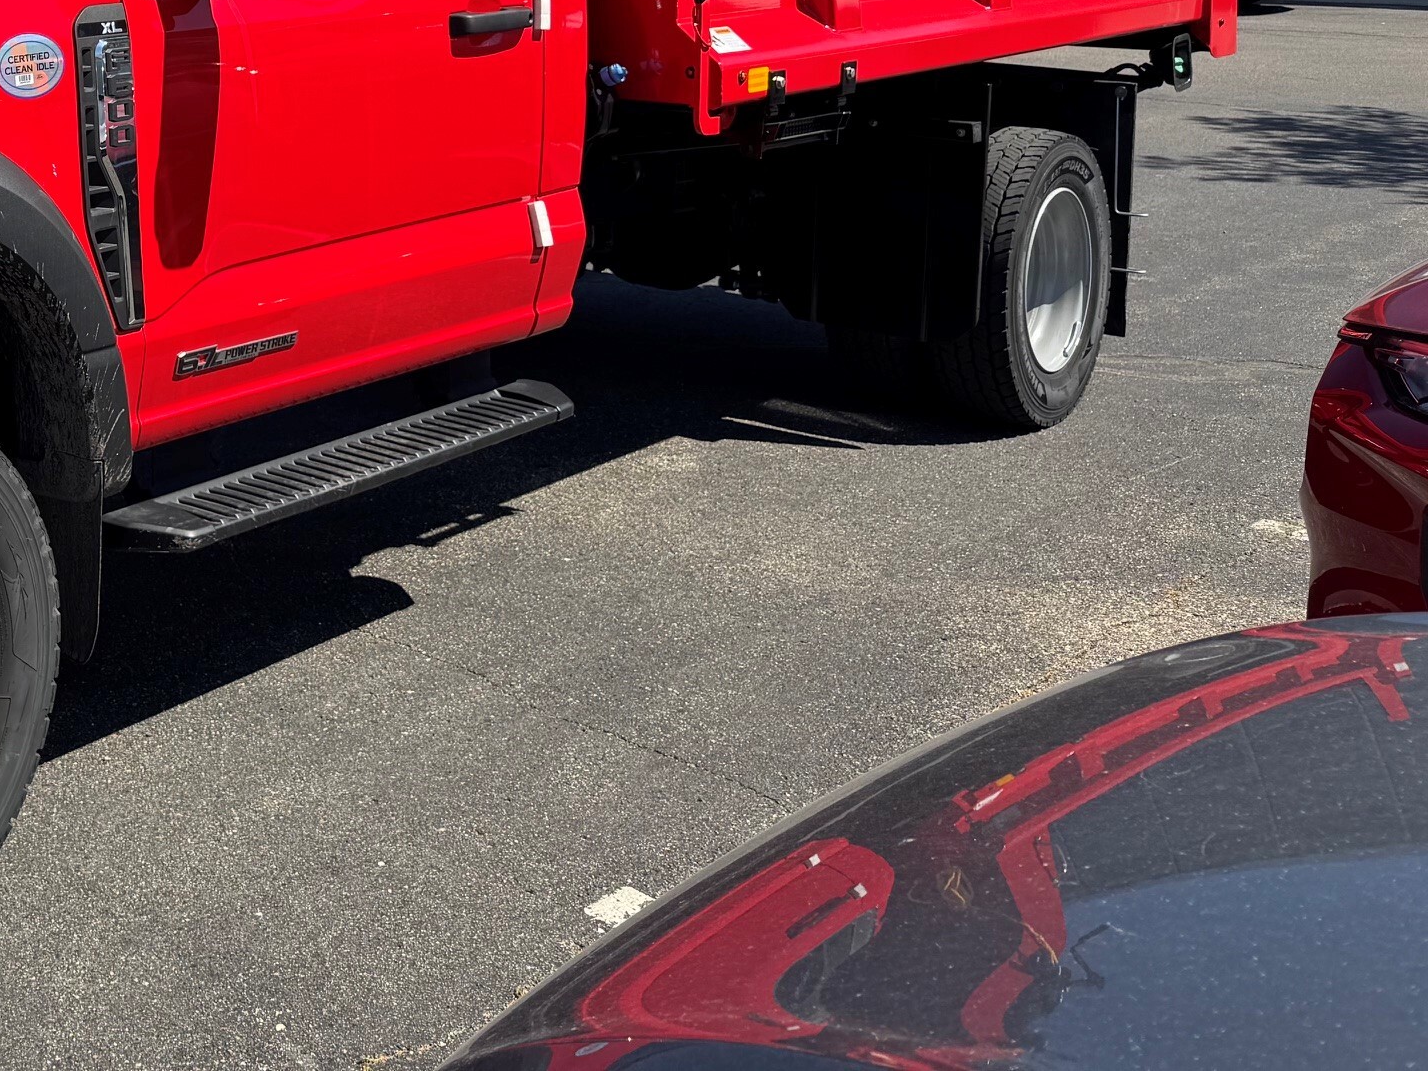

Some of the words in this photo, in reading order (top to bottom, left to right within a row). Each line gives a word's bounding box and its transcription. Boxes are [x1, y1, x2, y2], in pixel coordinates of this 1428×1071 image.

[100, 21, 123, 35] XL
[7, 51, 50, 64] CERTIFIED
[4, 64, 33, 76] CLEAN
[36, 61, 55, 72] IDLE
[1070, 159, 1090, 180] DH35
[177, 346, 223, 376] 6.7L
[225, 342, 259, 360] POWER
[260, 333, 297, 351] STROKE
